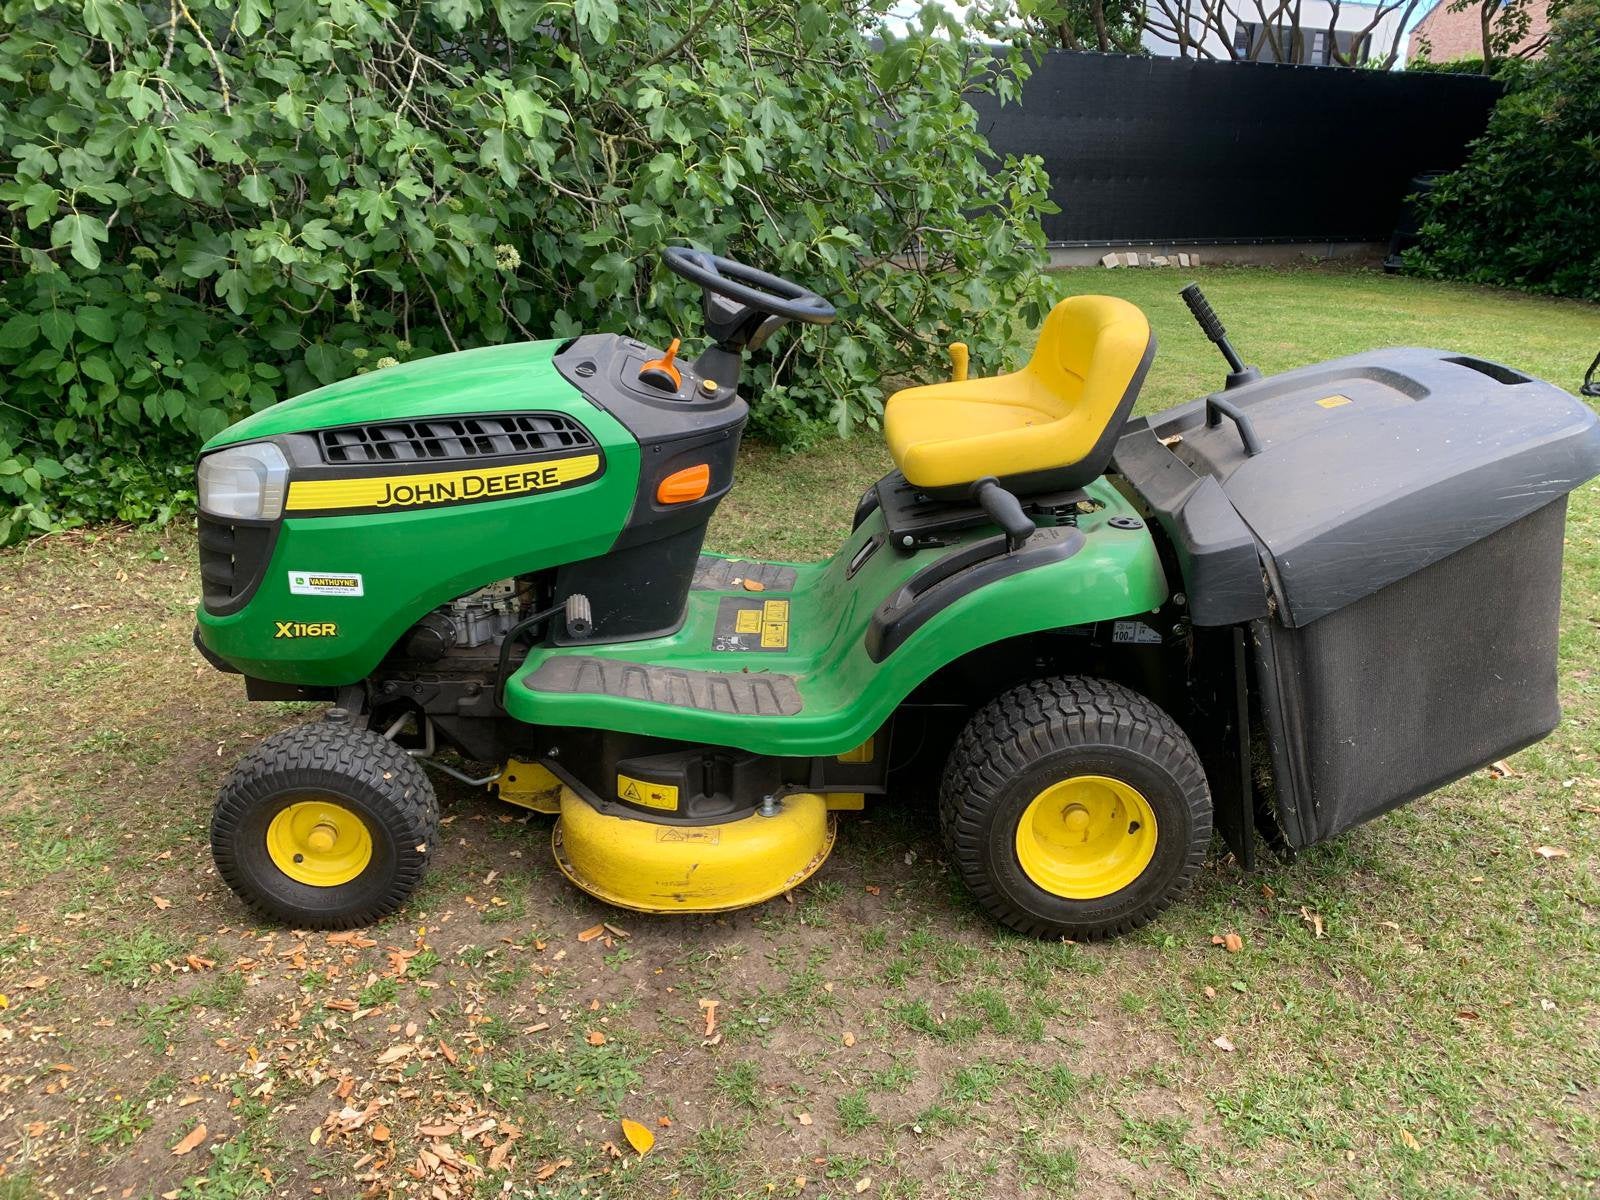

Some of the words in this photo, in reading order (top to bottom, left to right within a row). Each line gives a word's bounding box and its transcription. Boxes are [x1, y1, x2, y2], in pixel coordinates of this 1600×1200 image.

[377, 482, 455, 505] JOHN
[462, 467, 558, 496] DEERE
[309, 578, 355, 587] VANTHUYNE
[274, 622, 336, 638] X116R
[1114, 631, 1129, 641] 100
